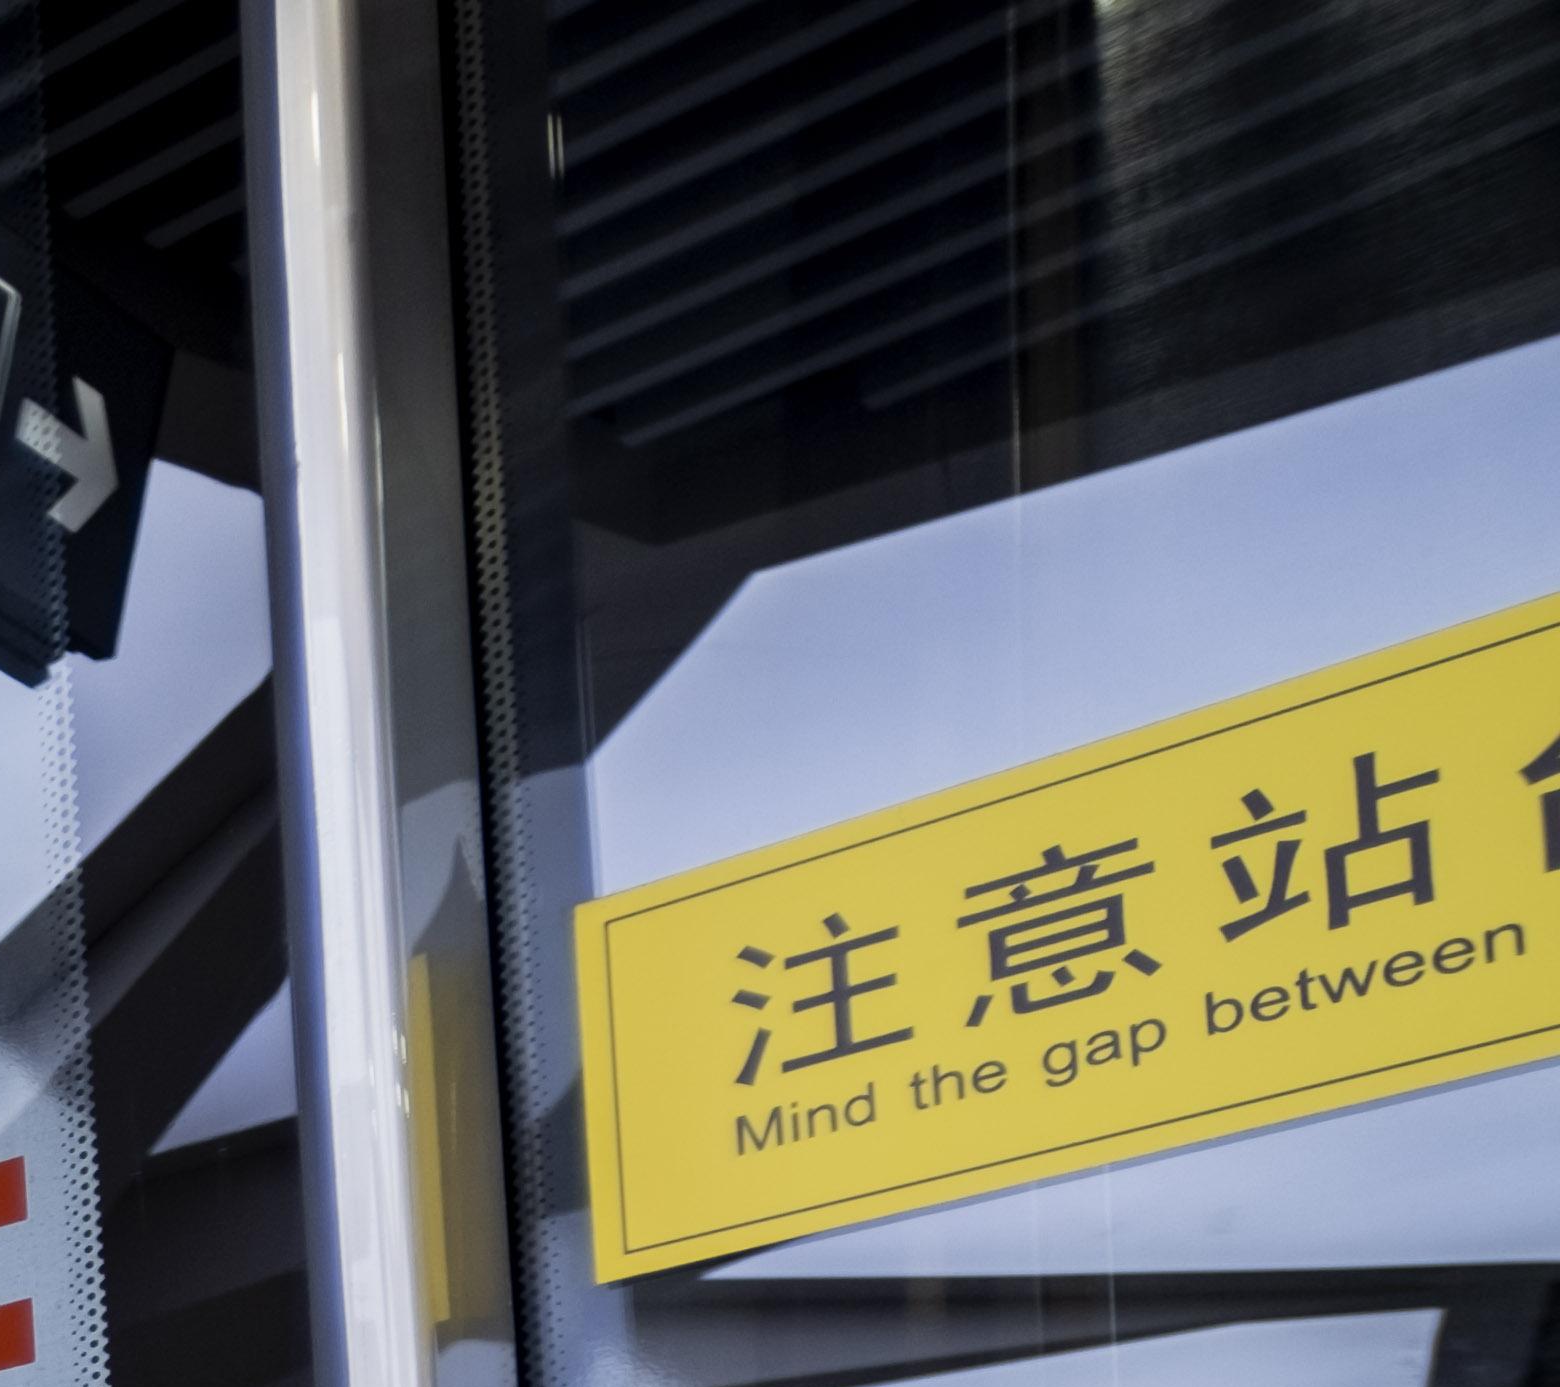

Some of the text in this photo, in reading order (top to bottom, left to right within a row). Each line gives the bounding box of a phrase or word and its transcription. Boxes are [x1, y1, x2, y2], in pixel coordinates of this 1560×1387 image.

[728, 724, 1560, 1089] 注意站
[732, 918, 1528, 1158] Mind the gap between
